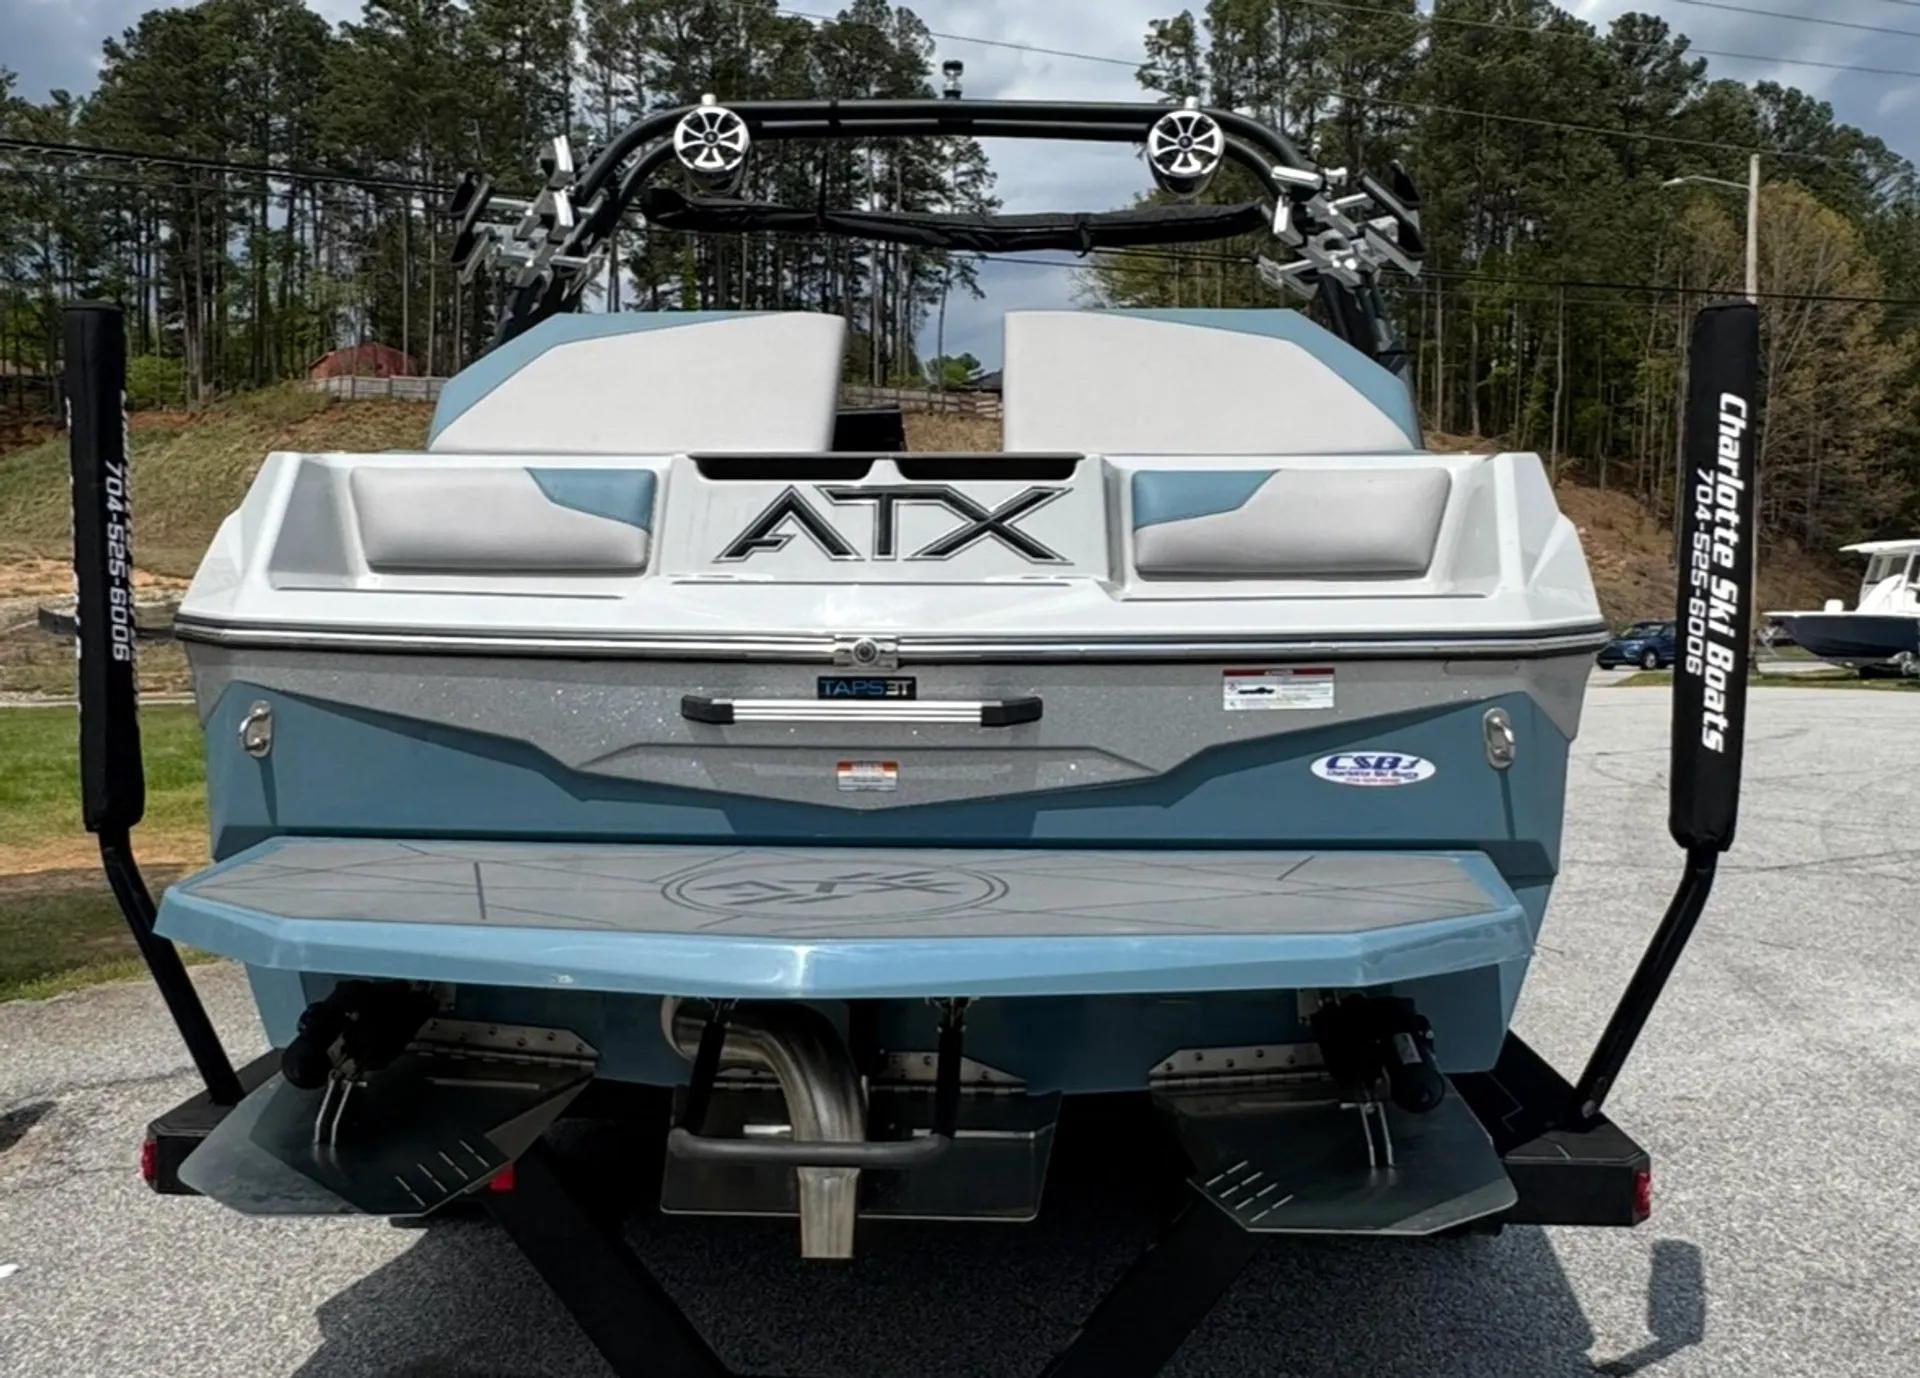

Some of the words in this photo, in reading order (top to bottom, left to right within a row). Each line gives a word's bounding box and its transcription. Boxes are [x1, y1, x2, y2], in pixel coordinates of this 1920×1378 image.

[711, 483, 1075, 566] ATX
[1712, 391, 1748, 569] Charlotte
[104, 459, 130, 662] 704-525-6006
[1685, 467, 1715, 677] 704-525-6006
[1708, 574, 1739, 638] Ski
[1701, 642, 1736, 754] Boats
